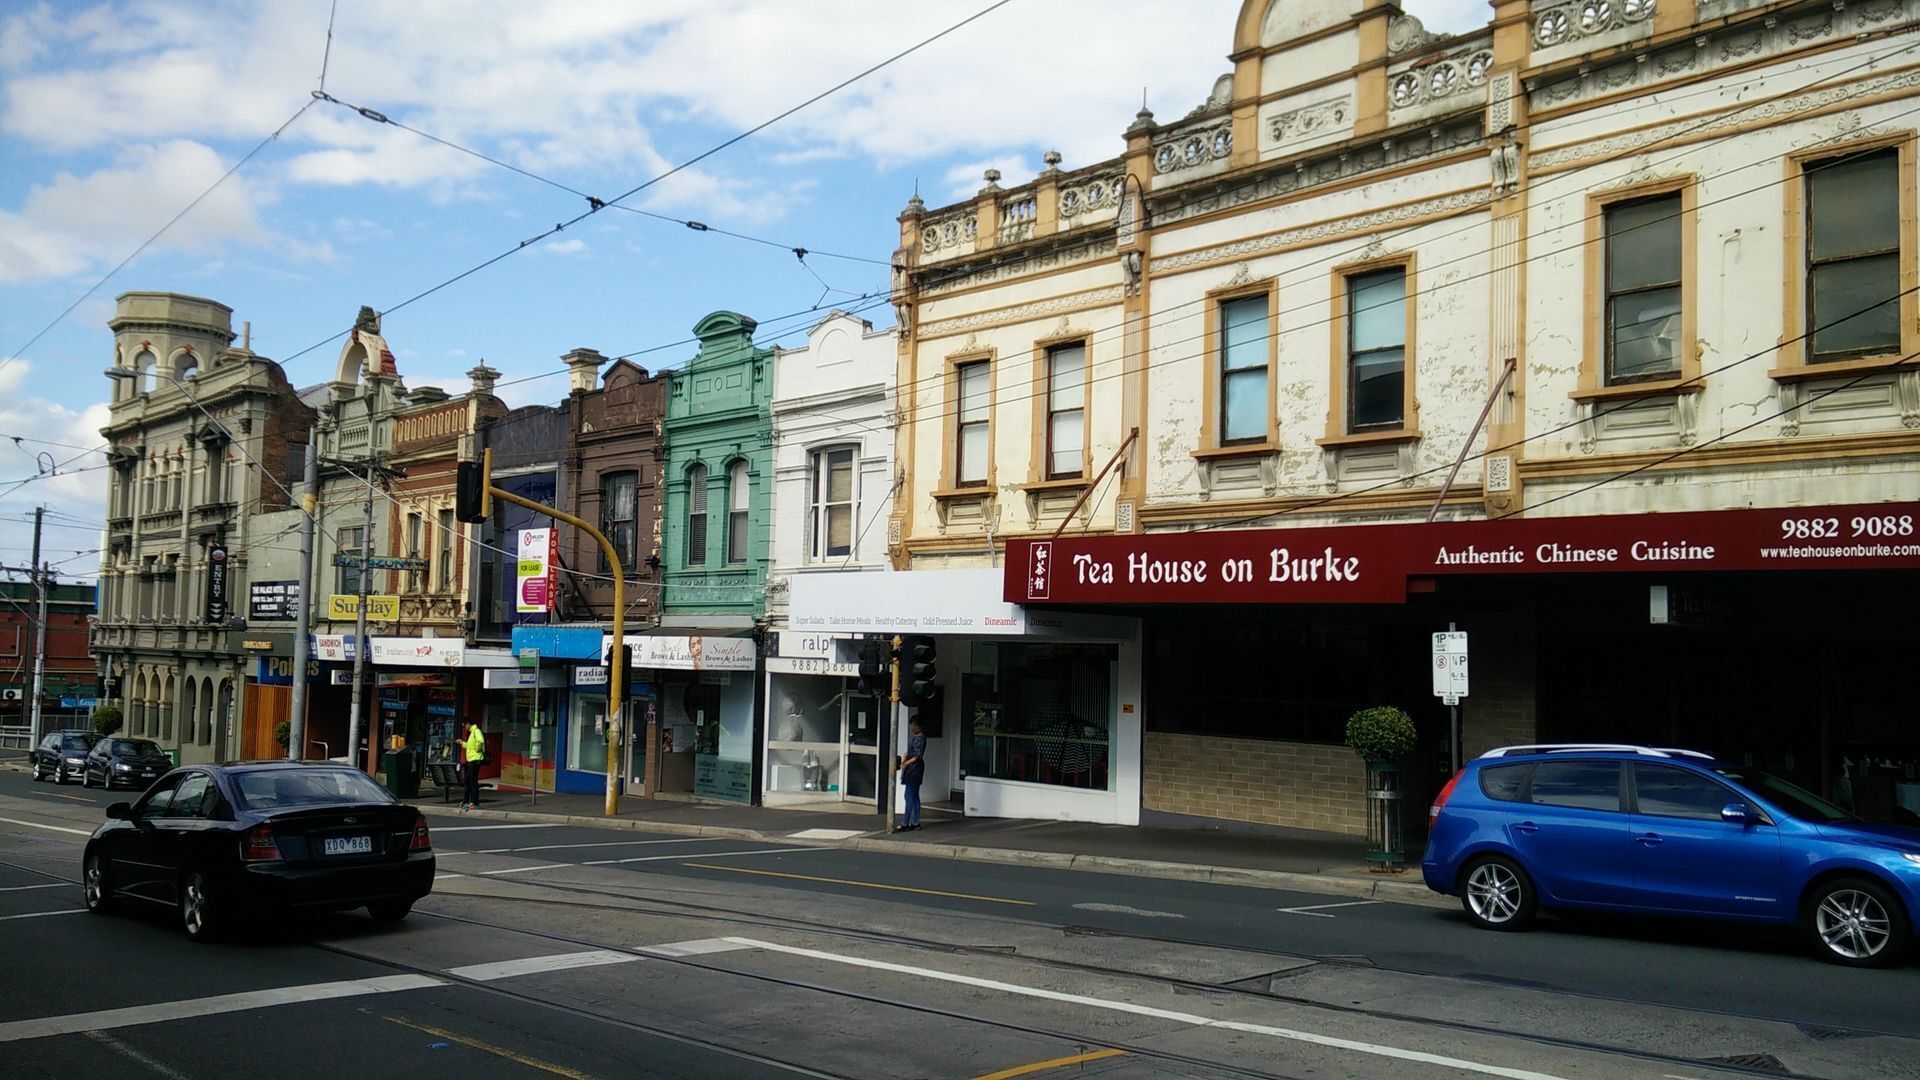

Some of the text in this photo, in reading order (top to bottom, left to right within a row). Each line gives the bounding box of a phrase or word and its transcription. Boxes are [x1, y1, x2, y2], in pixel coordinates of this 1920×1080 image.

[1781, 515, 1914, 539] 9882 9088
[1434, 541, 1715, 566] Authentic Chinese Cuisine
[1760, 544, 1920, 558] www.teahouseonburke.com
[1073, 547, 1360, 584] Tea House on Burke
[213, 564, 222, 597] ENTRY
[333, 598, 394, 618] Suday
[984, 617, 1018, 626] Dineamic
[318, 639, 342, 648] SANDWICH
[802, 634, 835, 654] ralp
[1435, 634, 1446, 643] 1P
[326, 648, 336, 657] BAR
[792, 659, 818, 672] 9882
[352, 838, 370, 849] 868
